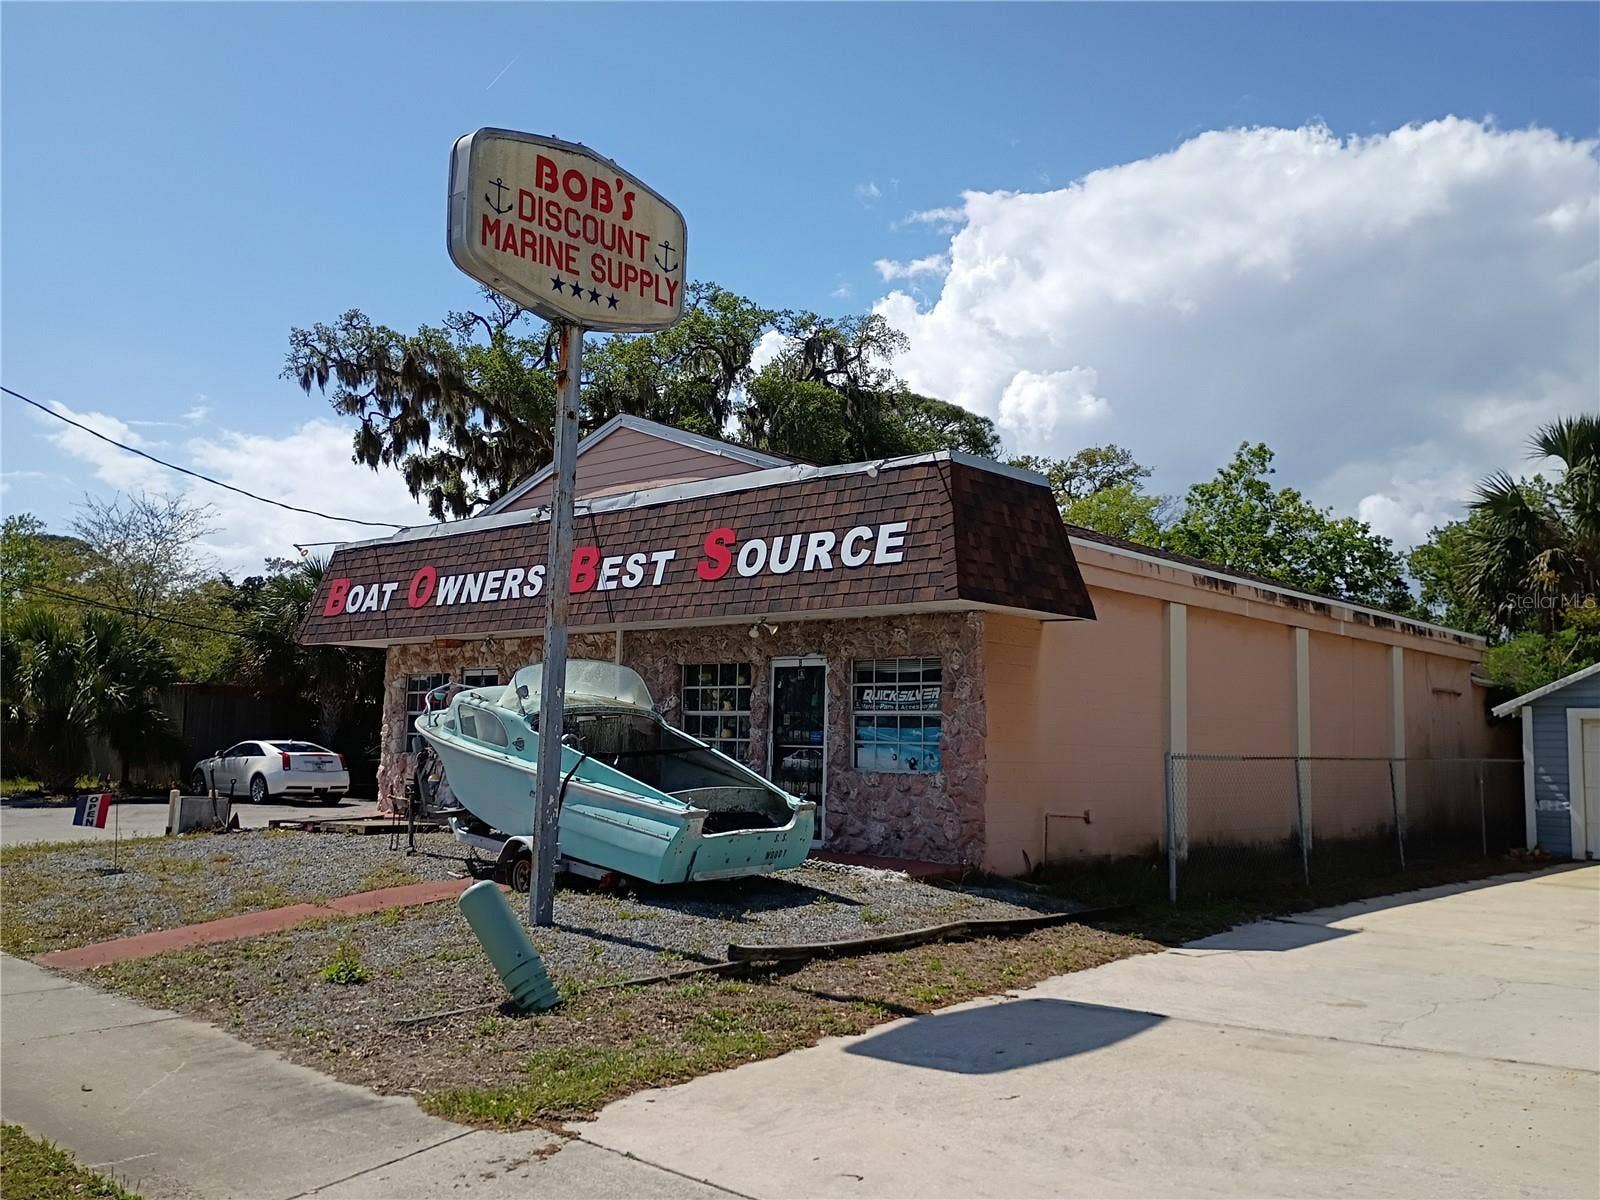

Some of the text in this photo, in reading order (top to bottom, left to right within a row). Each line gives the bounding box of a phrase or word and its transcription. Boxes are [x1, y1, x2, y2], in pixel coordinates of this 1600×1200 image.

[535, 154, 635, 221] BOB'S
[481, 214, 679, 307] MARINE SUPPLY
[518, 188, 650, 262] DISCOUNT
[323, 521, 908, 617] BOAT OWNERS BEST SOURCE
[85, 796, 99, 826] OPEN
